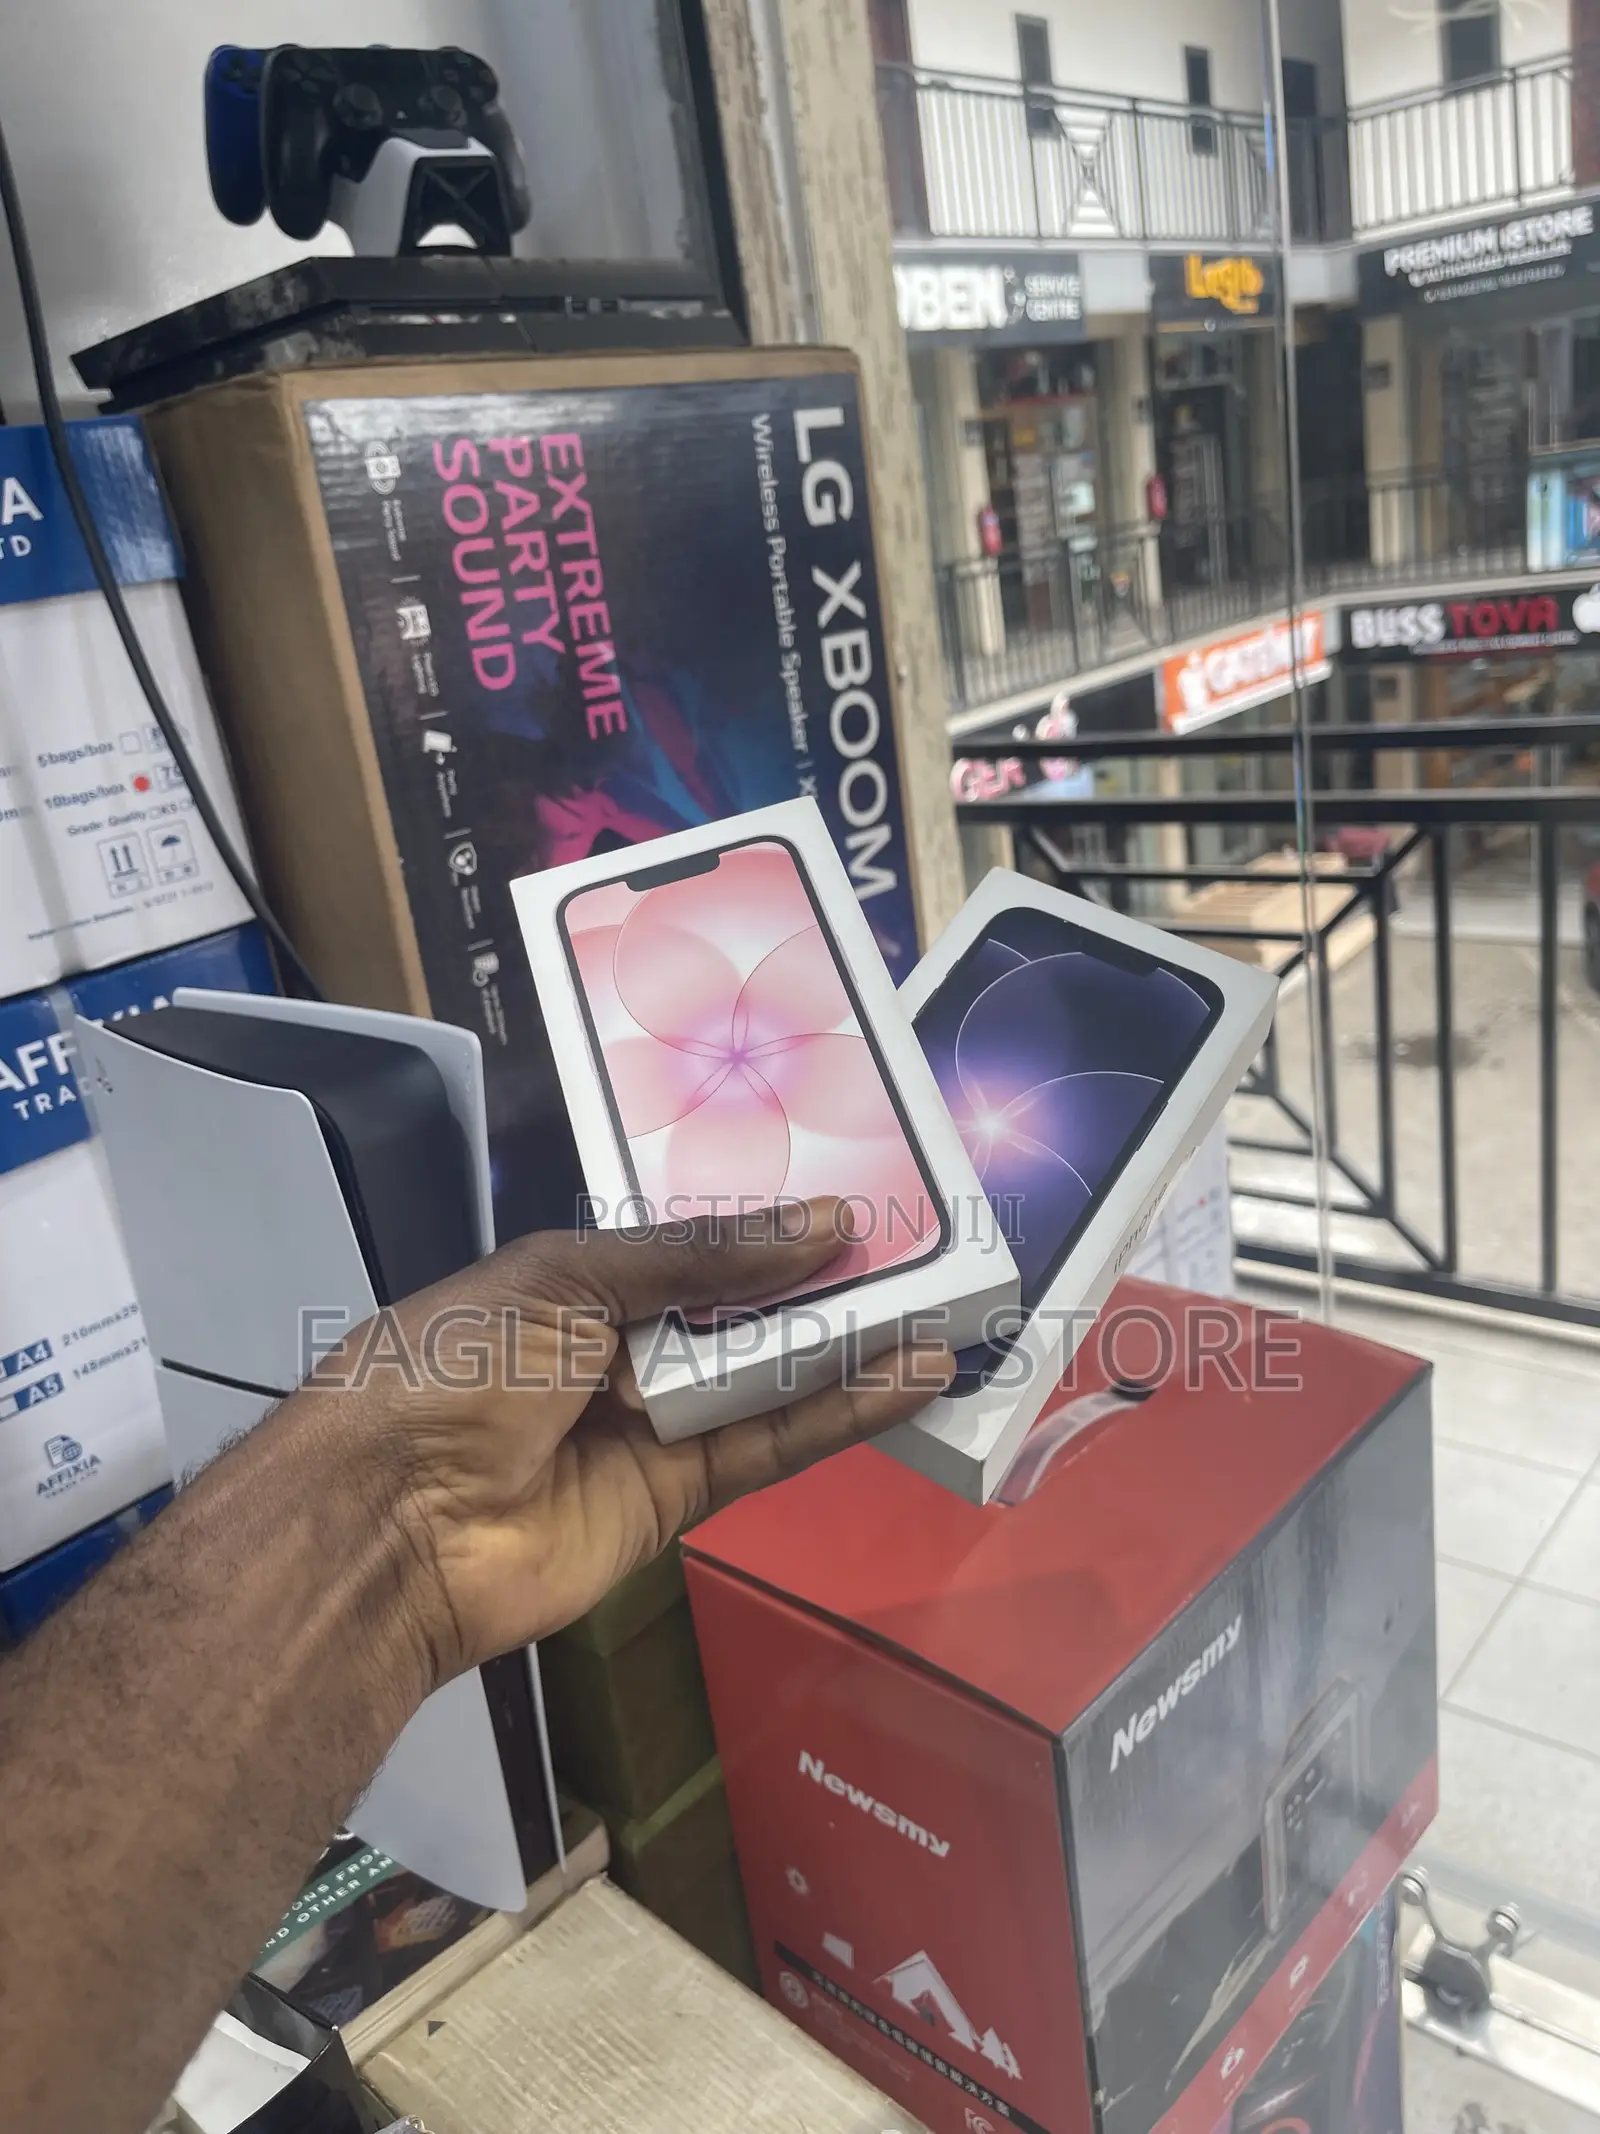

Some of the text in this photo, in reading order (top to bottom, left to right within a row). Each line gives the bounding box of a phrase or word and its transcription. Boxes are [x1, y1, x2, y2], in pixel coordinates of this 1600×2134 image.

[1384, 226, 1499, 277] PREMIUM
[752, 413, 779, 532] Wireless
[432, 438, 516, 690] SOUND
[487, 436, 566, 654] PARTY
[540, 433, 628, 740] EXTREME
[766, 536, 797, 648] Portable
[793, 407, 897, 900] LG XBOOM
[1351, 603, 1446, 649] BLISS
[779, 651, 809, 753] Speaker
[17, 1343, 49, 1372] A4
[29, 1375, 60, 1405] A5
[1110, 1613, 1242, 1774] Newsmy
[798, 1749, 951, 1859] Newsmy
[260, 1926, 290, 1954] ND
[296, 1879, 361, 1923] OTHER
